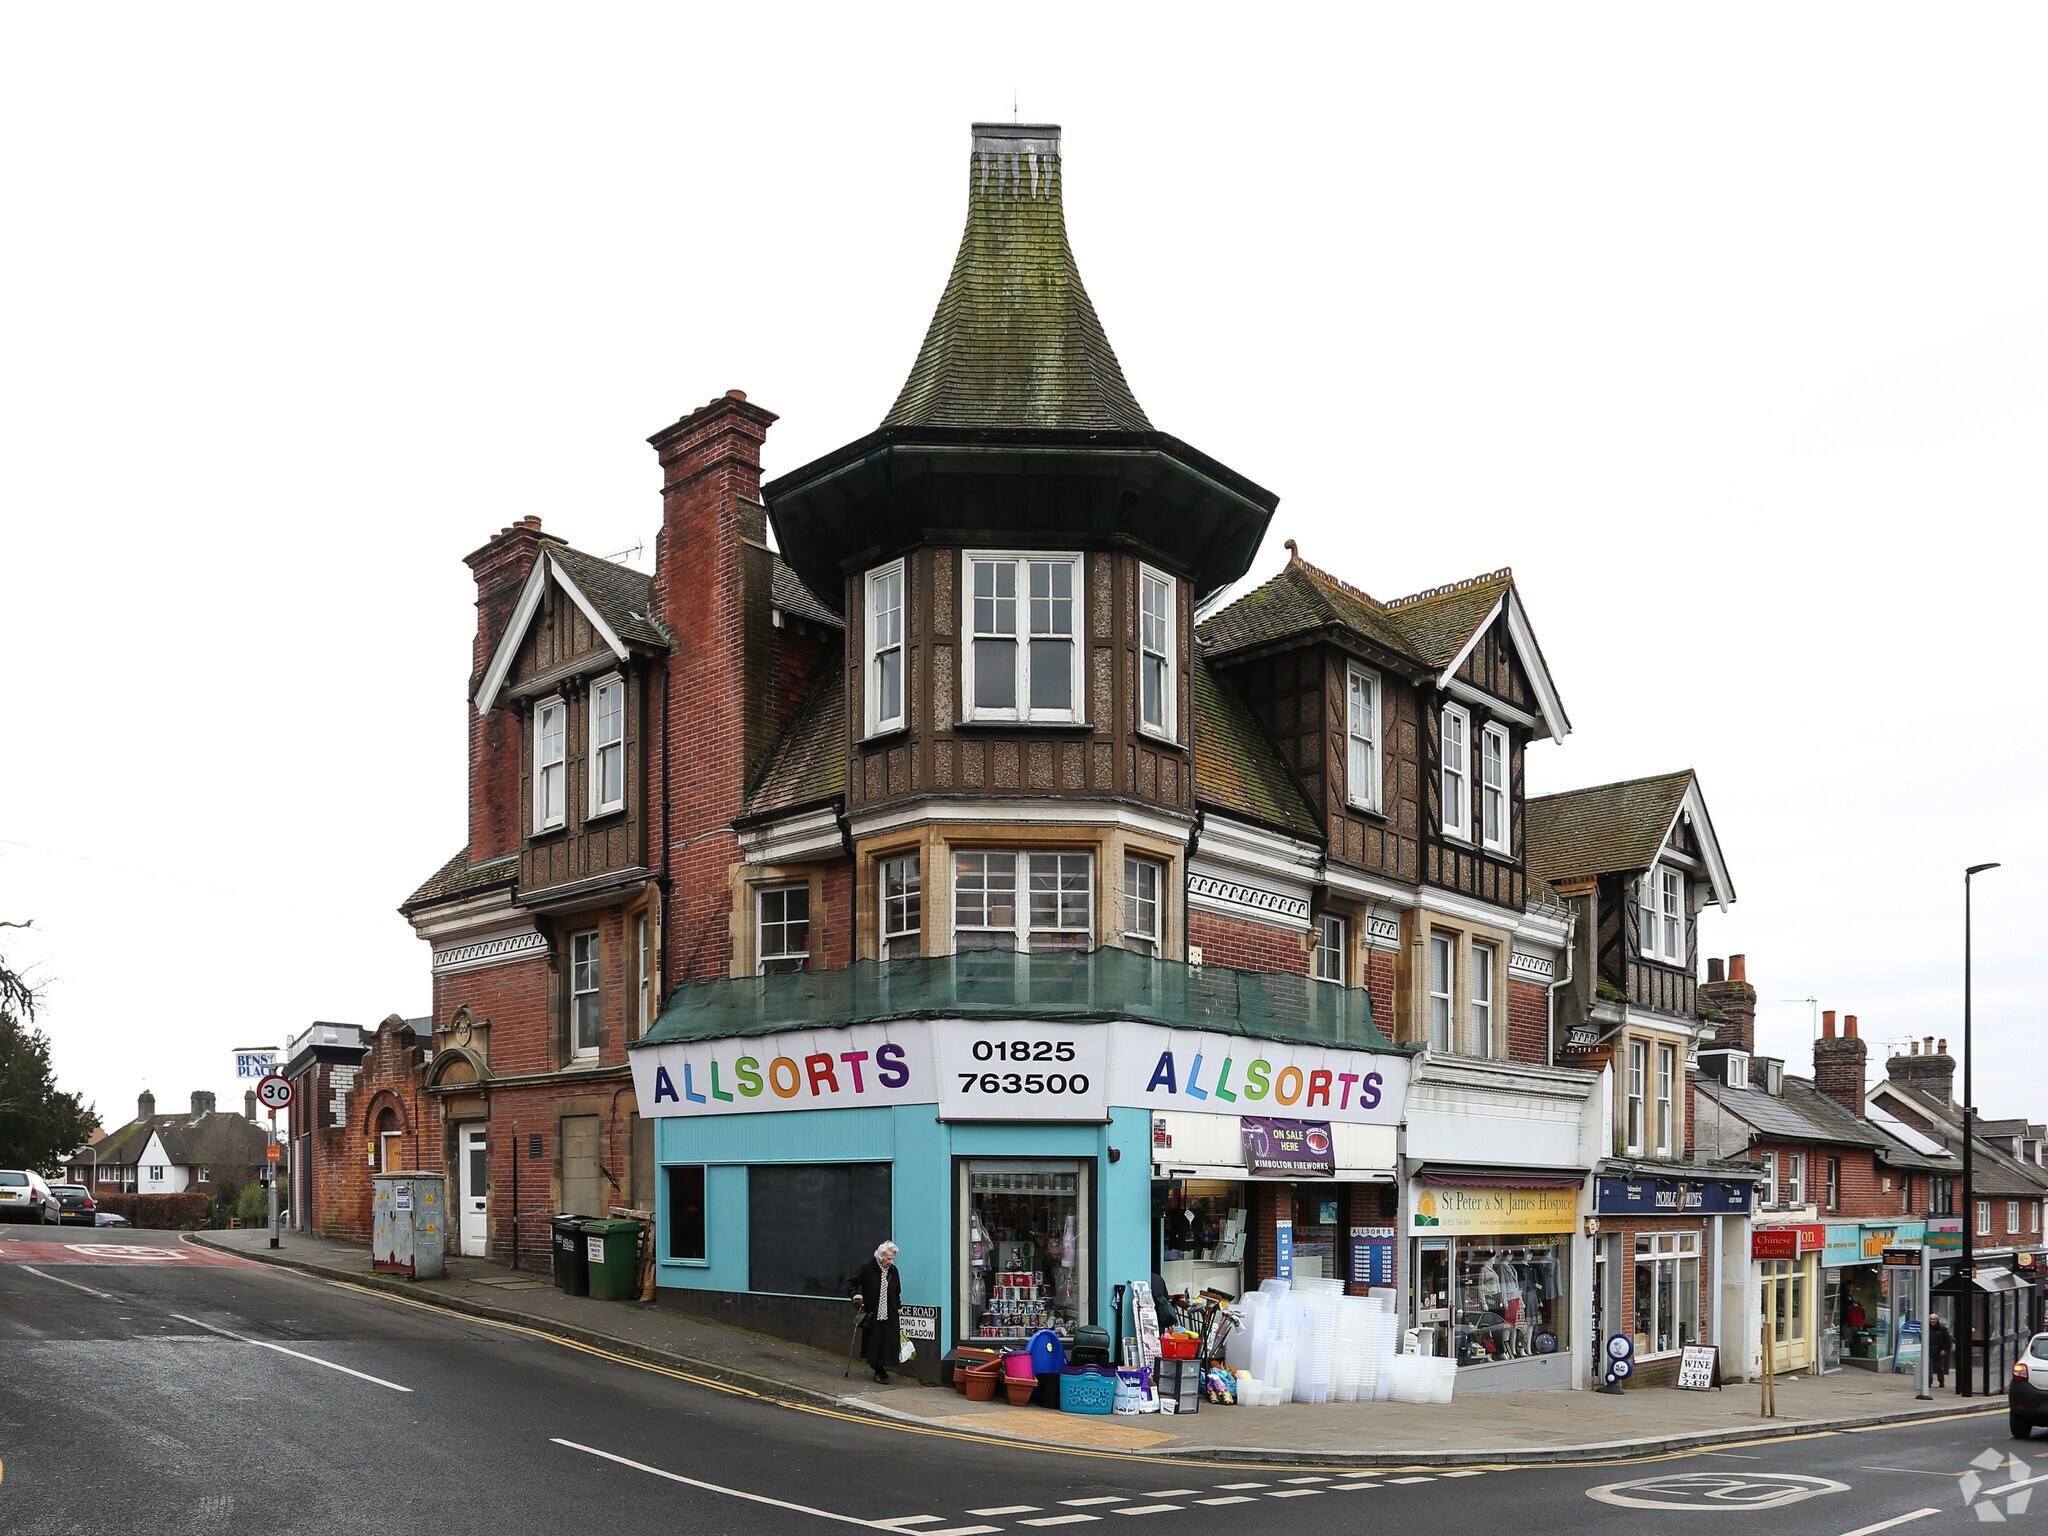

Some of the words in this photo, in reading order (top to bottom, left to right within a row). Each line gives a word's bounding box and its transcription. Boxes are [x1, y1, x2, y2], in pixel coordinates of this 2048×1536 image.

[973, 1041, 1076, 1062] 01825
[237, 1055, 268, 1066] BENS
[654, 1043, 910, 1104] ALLSORTS
[958, 1073, 1089, 1094] 763500
[1146, 1051, 1384, 1110] ALLSORTS
[263, 1085, 290, 1100] 30
[1273, 1129, 1285, 1139] ON
[1285, 1130, 1304, 1140] SALE
[1280, 1141, 1300, 1152] HERE
[1254, 1159, 1293, 1169] KIMBOLTON
[1293, 1161, 1329, 1170] FIREWORKS
[1442, 1190, 1454, 1211] St
[1456, 1191, 1483, 1211] Peter
[1484, 1199, 1491, 1211] &
[1494, 1191, 1504, 1211] St
[1506, 1192, 1536, 1216] James
[1538, 1193, 1573, 1216] Hospice
[1655, 1191, 1677, 1205] NOBLE
[1685, 1192, 1703, 1205] WINES
[1756, 1235, 1792, 1244] Chinese
[912, 1306, 935, 1317] ROAD
[917, 1319, 927, 1327] TO
[905, 1328, 934, 1338] MEADOW
[1684, 1359, 1712, 1369] WINE
